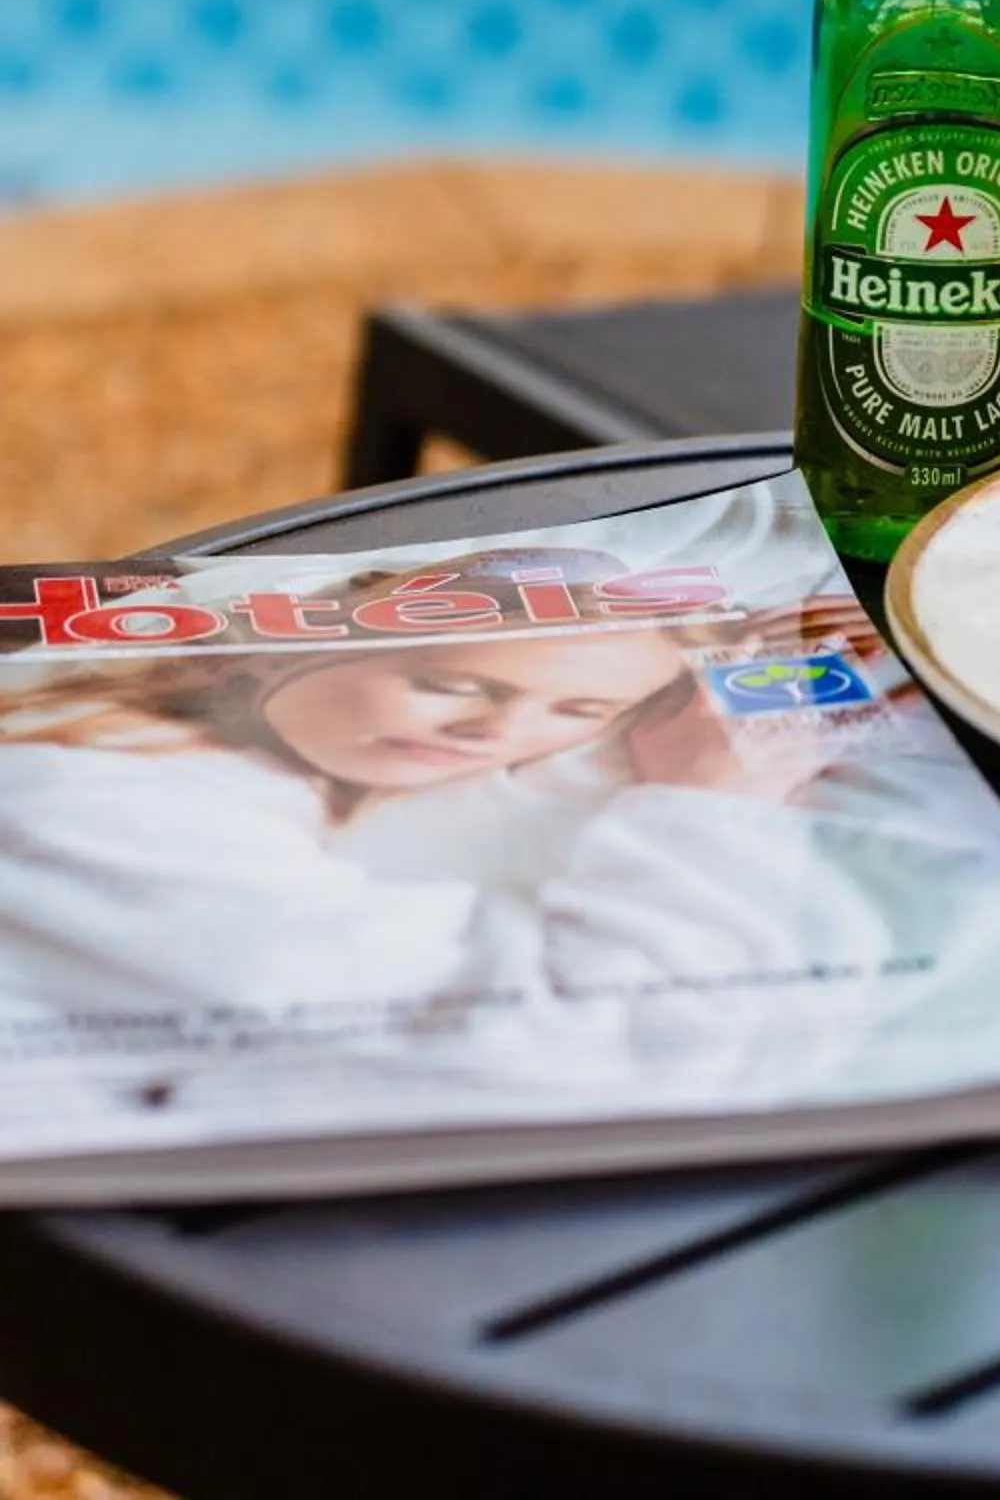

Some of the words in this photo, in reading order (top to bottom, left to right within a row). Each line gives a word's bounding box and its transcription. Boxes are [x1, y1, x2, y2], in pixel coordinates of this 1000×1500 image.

[847, 150, 944, 231] HEINEKEN
[845, 364, 894, 425] PURE
[898, 412, 965, 441] MALT
[911, 467, 962, 486] 330ml
